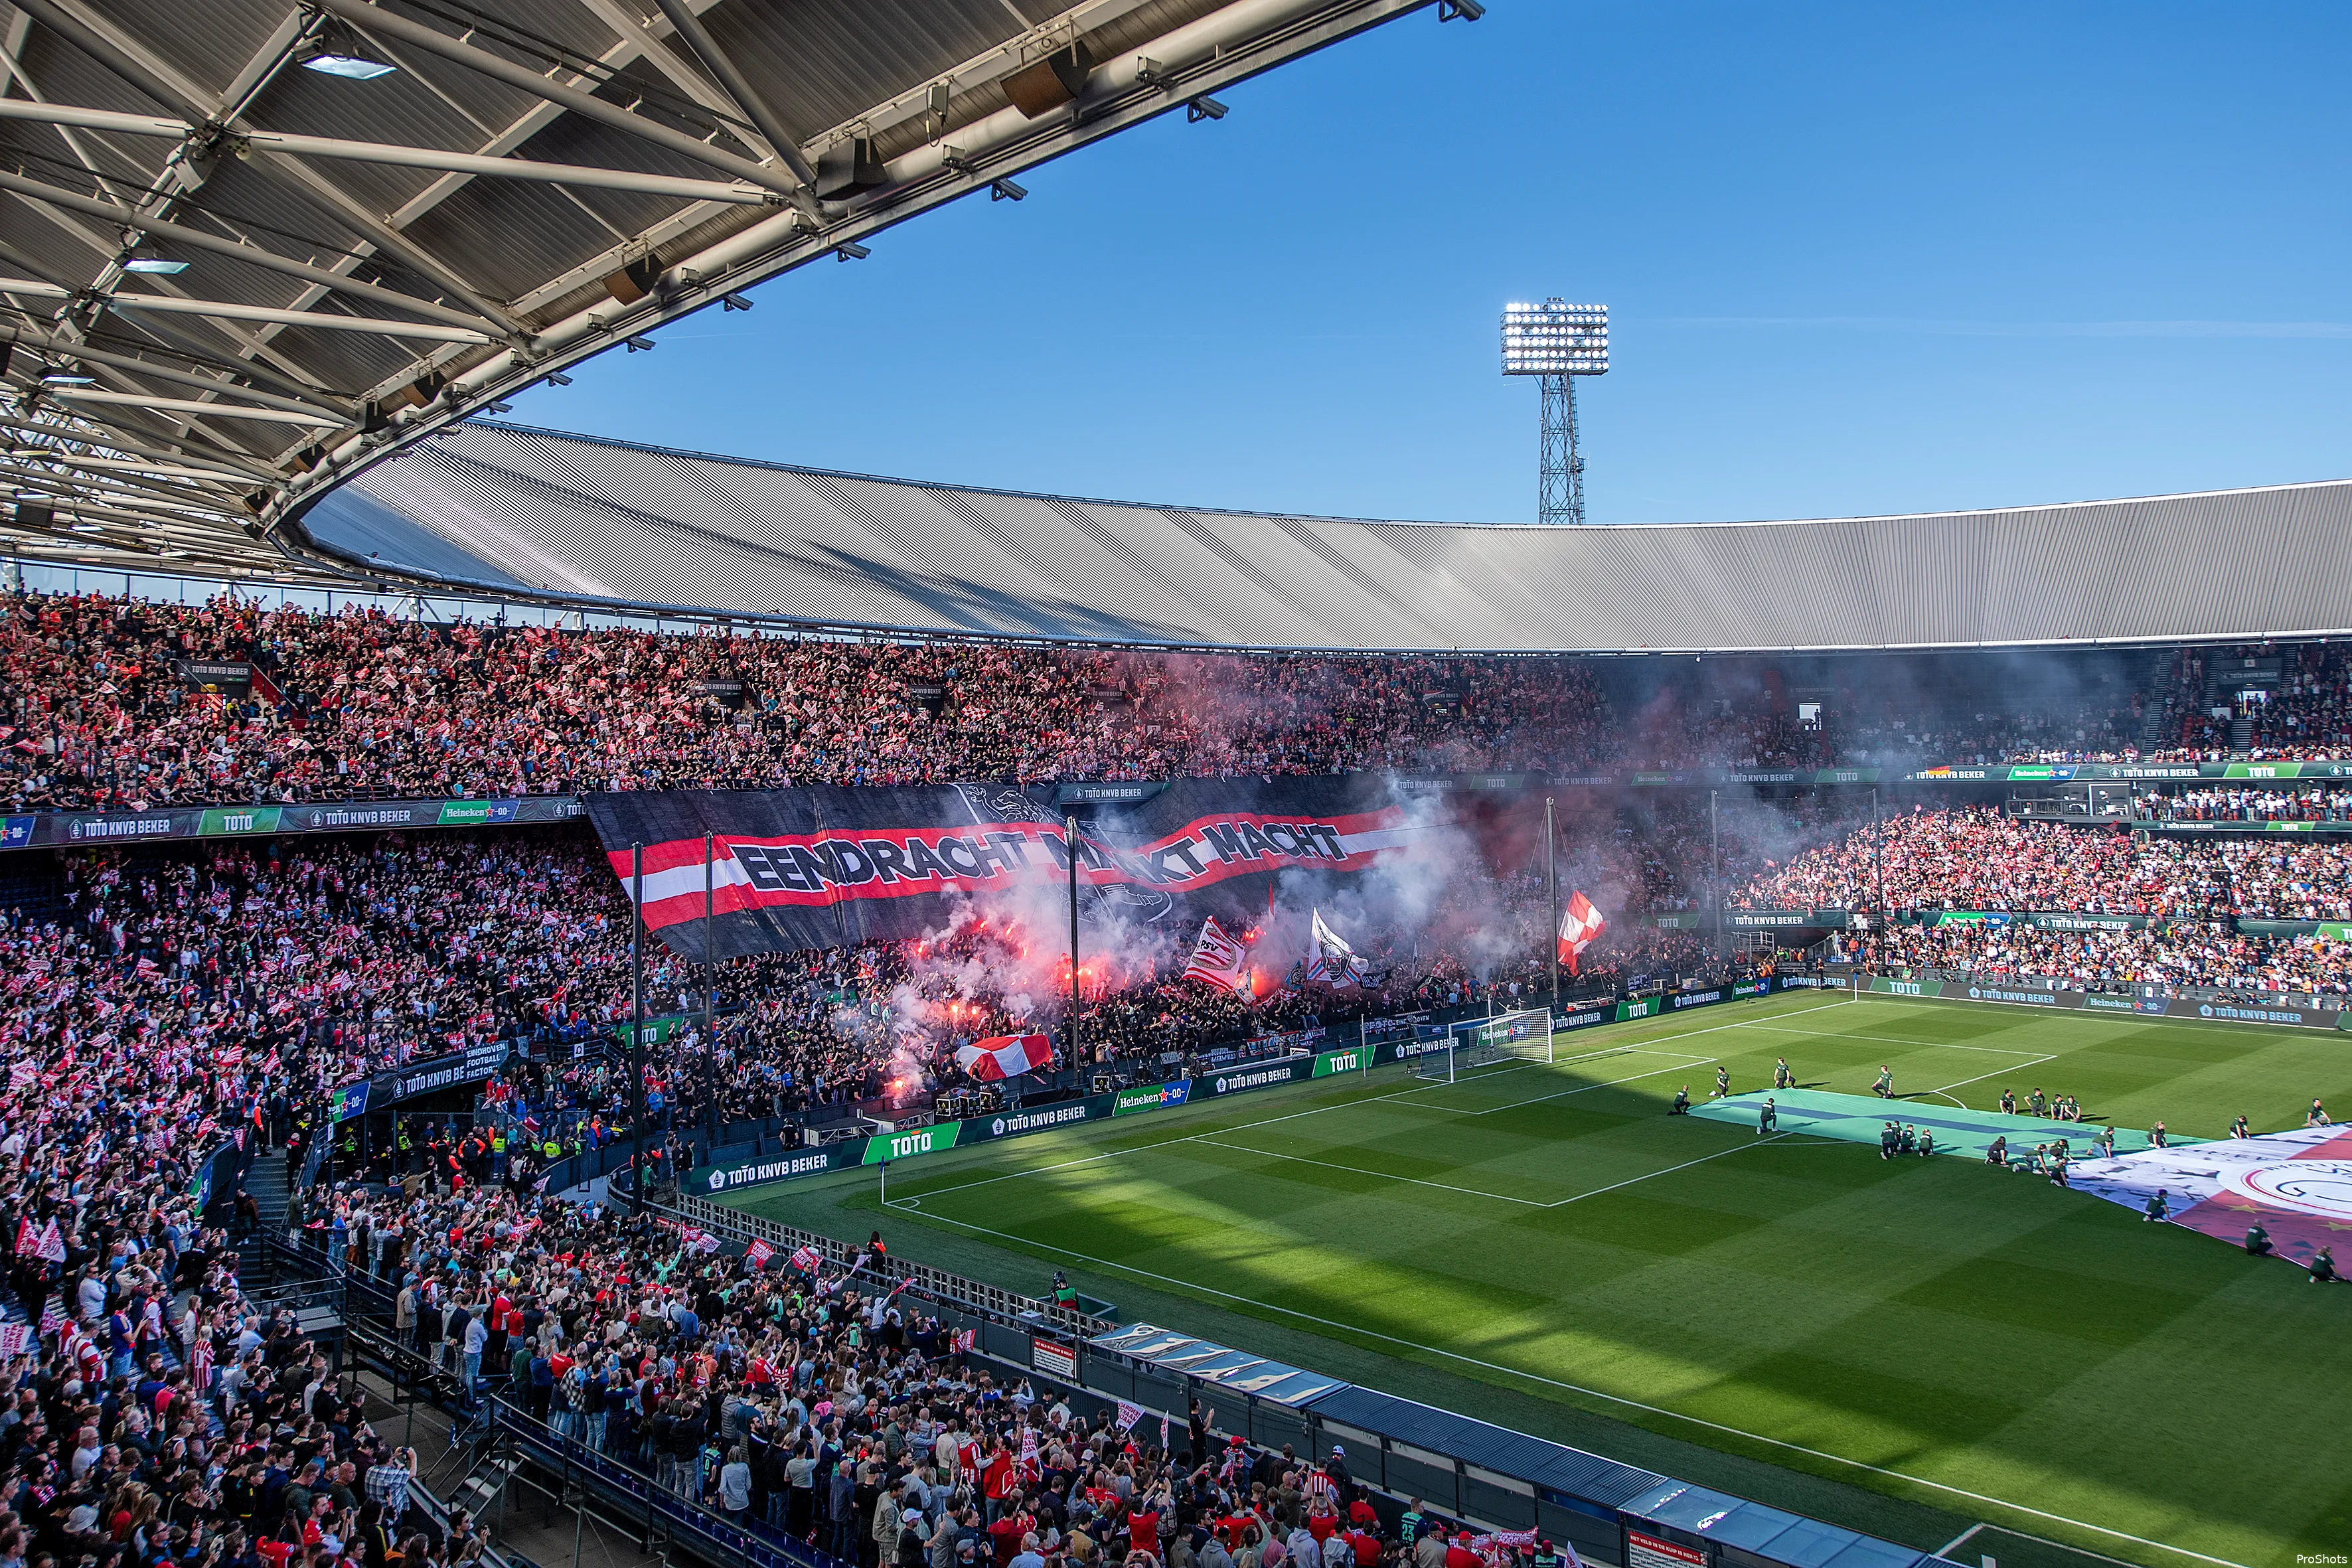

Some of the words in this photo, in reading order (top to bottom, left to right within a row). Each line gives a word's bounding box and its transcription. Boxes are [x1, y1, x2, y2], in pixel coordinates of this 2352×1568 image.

[227, 667, 248, 676] BEKER
[1836, 772, 1857, 781] TOTO
[2122, 769, 2144, 777] TOTO
[2170, 768, 2199, 777] BEKER
[2247, 767, 2276, 777] TOTO
[1487, 779, 1506, 787] TOTO
[1085, 789, 1101, 798] TOTO
[1102, 789, 1119, 797] KNVB
[1120, 788, 1142, 797] BEKER
[326, 812, 349, 824] TOTO
[351, 811, 378, 824] KNVB
[379, 810, 411, 823] BEKER
[446, 803, 485, 817] Heineken
[85, 822, 108, 837] TOTO
[108, 821, 136, 836] KNVB
[137, 819, 171, 834] BEKER
[224, 815, 254, 831] TOTO
[730, 831, 1034, 893] EENDRACHT
[1038, 831, 1209, 885] MAAKT
[1199, 821, 1348, 864] MACHT
[1657, 918, 1678, 927] TOTO
[1735, 917, 1753, 925] TOTO
[1754, 916, 1776, 925] KNVB
[1777, 916, 1804, 925] BEKER
[2051, 919, 2073, 928] TOTO
[1200, 939, 1219, 952] PSV
[1798, 977, 1818, 986] KNVB
[1889, 982, 1921, 994] TOTO
[1682, 996, 1692, 1006] TOTO
[1693, 994, 1705, 1004] KNVB
[1705, 991, 1720, 1002] BEKER
[1982, 989, 2001, 999] TOTO
[2002, 990, 2025, 1001] KNVB
[2027, 992, 2055, 1004] BEKER
[2090, 998, 2132, 1009] Heineken
[1628, 1002, 1648, 1018] TOTO
[2214, 1007, 2238, 1017] TOTO
[2238, 1008, 2268, 1020] KNVB
[2268, 1011, 2302, 1023] BEKER
[1555, 1018, 1568, 1028] TOTO
[1569, 1015, 1583, 1026] KNVB
[1584, 1012, 1601, 1024] BEKER
[631, 1028, 657, 1044] TTO
[1482, 1028, 1508, 1040] Heneken
[467, 1043, 506, 1058] EINDHOVEN
[1421, 1041, 1439, 1053] KNVB
[467, 1054, 500, 1067] FOOTBALL
[1330, 1054, 1356, 1073] TOTO
[467, 1065, 497, 1079] FACTOR
[1228, 1075, 1246, 1090] TOTO
[1247, 1072, 1267, 1087] KNVB
[1269, 1068, 1291, 1083] BEKER
[406, 1075, 426, 1093] TOTO
[428, 1069, 451, 1087] KNVB
[1120, 1093, 1159, 1109] Heineken
[1007, 1115, 1028, 1131] TOTO
[1030, 1111, 1055, 1127] KNVB
[1057, 1106, 1085, 1122] BEKER
[891, 1133, 931, 1157] TOTO
[728, 1166, 755, 1185] TOTO
[757, 1161, 789, 1180] KNVB
[791, 1154, 828, 1174] BEKER
[1402, 1524, 1414, 1541] 23
